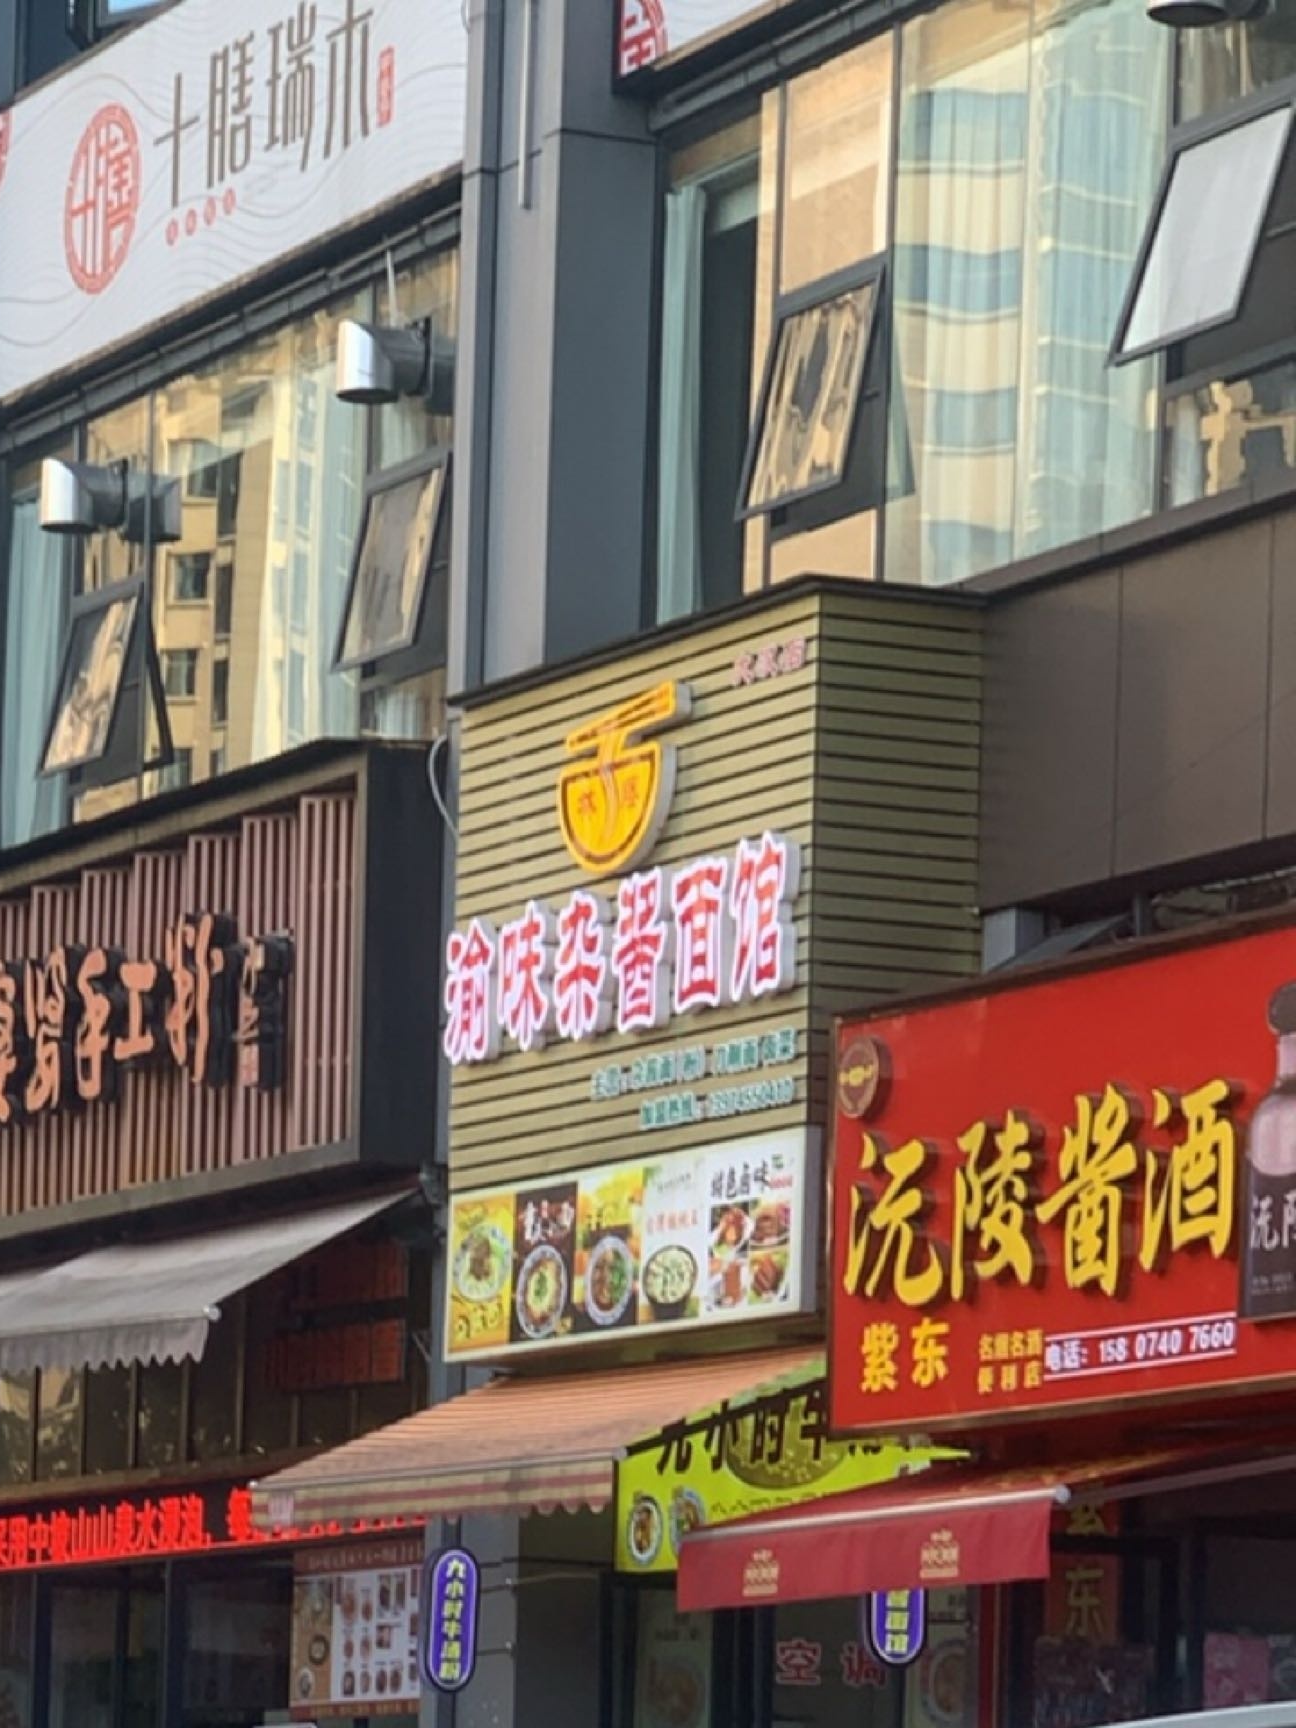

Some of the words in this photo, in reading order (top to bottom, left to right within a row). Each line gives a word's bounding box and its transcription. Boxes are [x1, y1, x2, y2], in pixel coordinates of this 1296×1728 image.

[443, 829, 790, 1066] 渝味杂酱面馆
[860, 1317, 950, 1393] 紫东
[1099, 1336, 1129, 1364] 158
[1135, 1328, 1182, 1360] 0740
[1188, 1318, 1235, 1352] 7660
